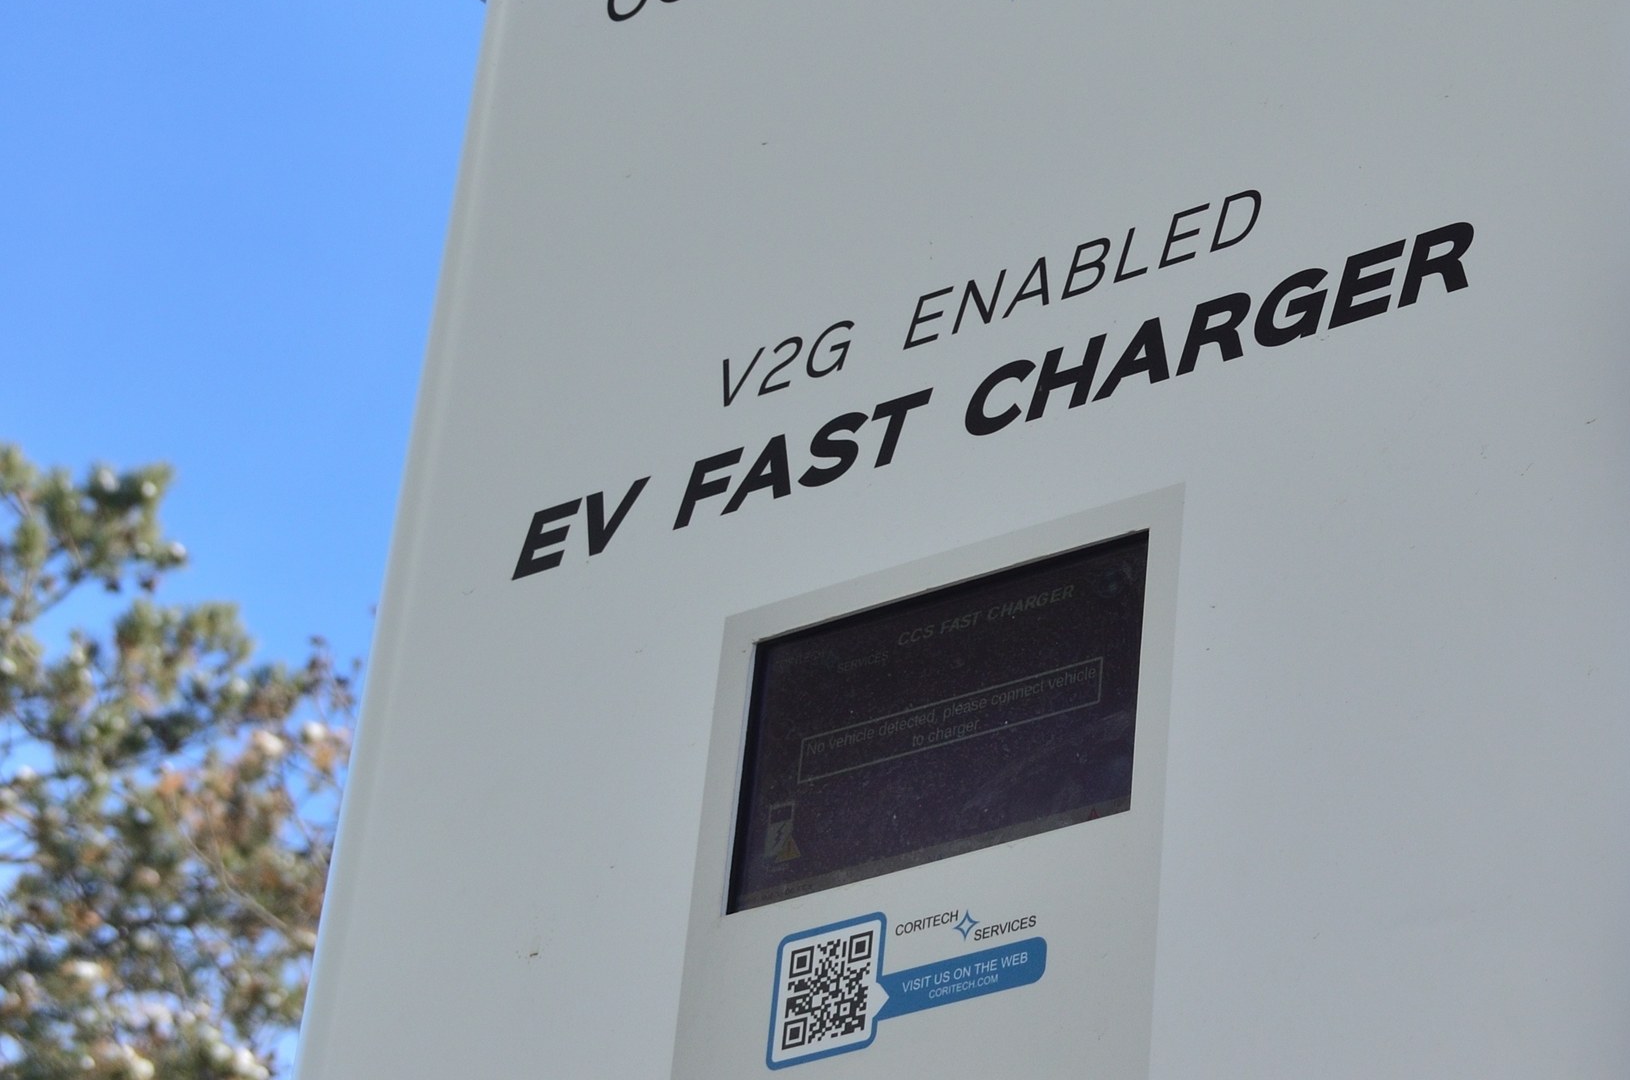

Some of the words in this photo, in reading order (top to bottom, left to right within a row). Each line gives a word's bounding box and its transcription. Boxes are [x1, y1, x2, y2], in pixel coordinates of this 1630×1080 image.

[722, 320, 855, 408] V2G
[902, 189, 1262, 351] ENABLED
[511, 476, 651, 581] EV
[672, 387, 934, 531] FAST
[964, 221, 1475, 437] CHARGER
[897, 625, 934, 646] CCS
[939, 611, 983, 634] FAST
[986, 584, 1075, 621] CHARGER
[806, 741, 825, 756] No
[829, 727, 875, 750] vehicle
[943, 698, 988, 721] please
[990, 683, 1044, 706] connect
[1048, 666, 1097, 689] vehicle
[912, 733, 924, 747] to
[894, 909, 959, 936] CORITECH
[973, 915, 1037, 941] SERVICES
[901, 975, 932, 993] VISIT
[934, 970, 951, 985] US
[953, 965, 972, 980] ON
[974, 959, 999, 975] THE
[1001, 951, 1029, 969] WEB
[928, 974, 999, 999] CORITECH.COM
